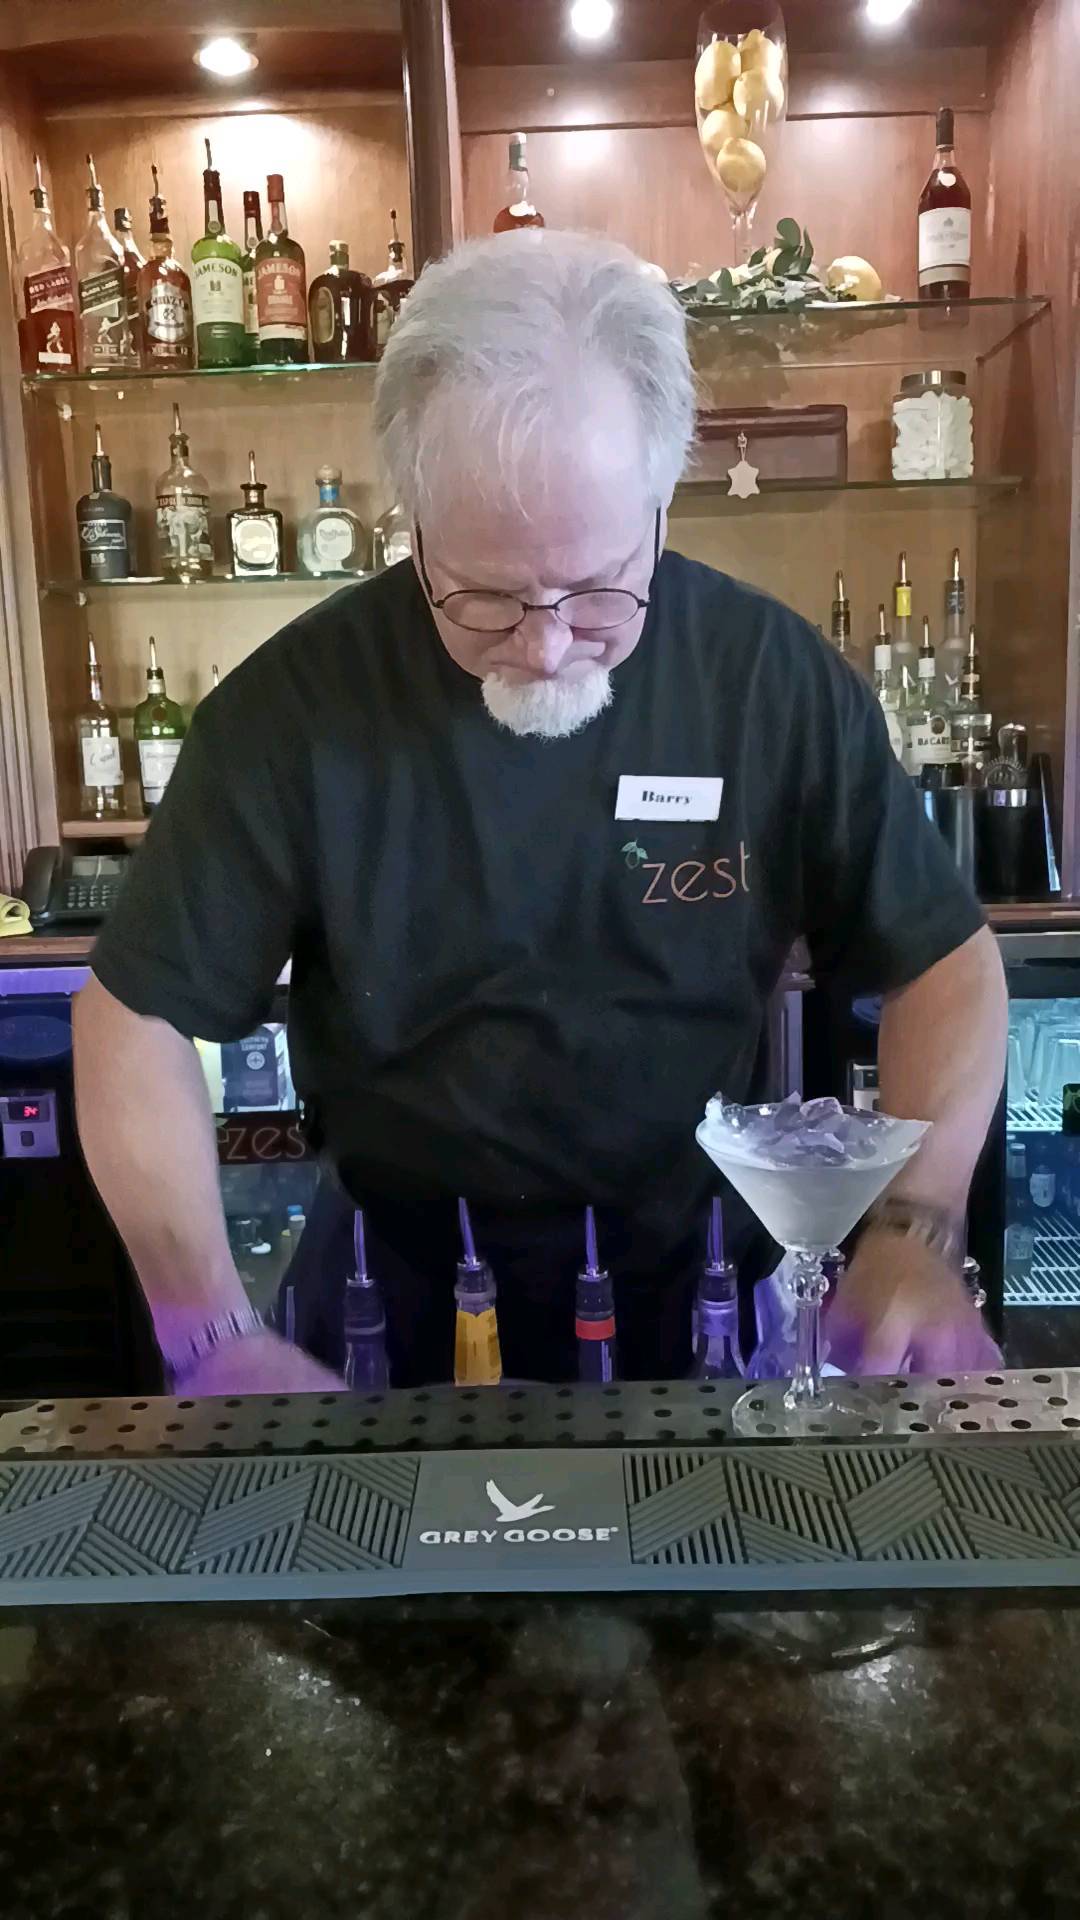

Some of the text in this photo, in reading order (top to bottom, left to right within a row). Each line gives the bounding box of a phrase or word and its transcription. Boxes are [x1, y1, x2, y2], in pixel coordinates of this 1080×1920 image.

[194, 263, 238, 280] JAMESON
[29, 276, 69, 294] RED LABEL
[642, 790, 693, 804] Barry
[642, 840, 751, 904] zest
[226, 1126, 306, 1160] zes
[419, 1530, 497, 1544] GREY
